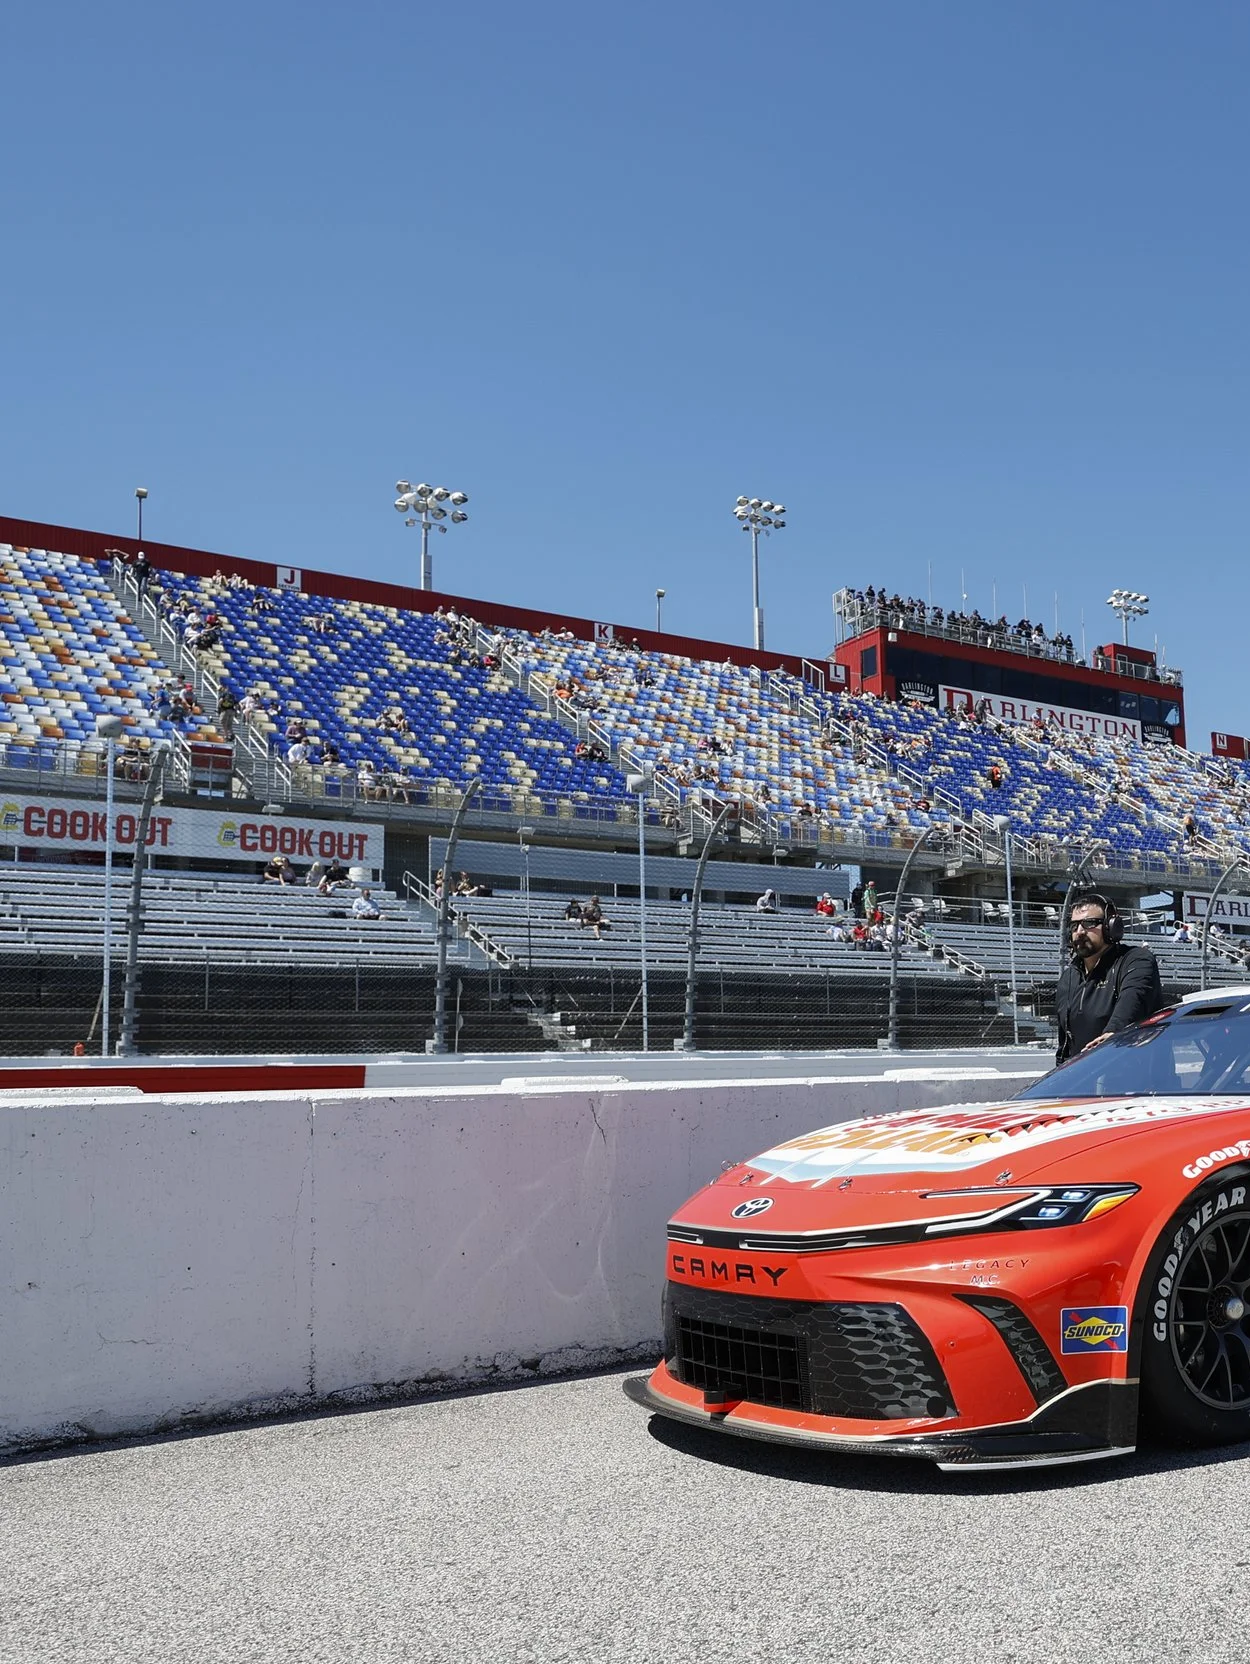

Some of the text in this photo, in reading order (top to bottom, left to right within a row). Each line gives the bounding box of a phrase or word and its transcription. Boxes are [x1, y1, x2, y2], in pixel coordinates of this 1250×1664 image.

[284, 569, 295, 584] J
[598, 624, 609, 639] K
[834, 665, 841, 678] L
[901, 682, 934, 695] DARLINGTON
[943, 688, 1138, 740] DARLINGTON
[1217, 733, 1226, 746] N
[23, 806, 108, 842] COOK
[239, 823, 369, 861] COOK OUT
[672, 1255, 788, 1287] CAMRY
[950, 1259, 1030, 1270] LEGACY
[1153, 1186, 1247, 1342] GOODYEAR
[971, 1275, 1001, 1286] M.C.
[1066, 1324, 1123, 1338] SUNOCO
